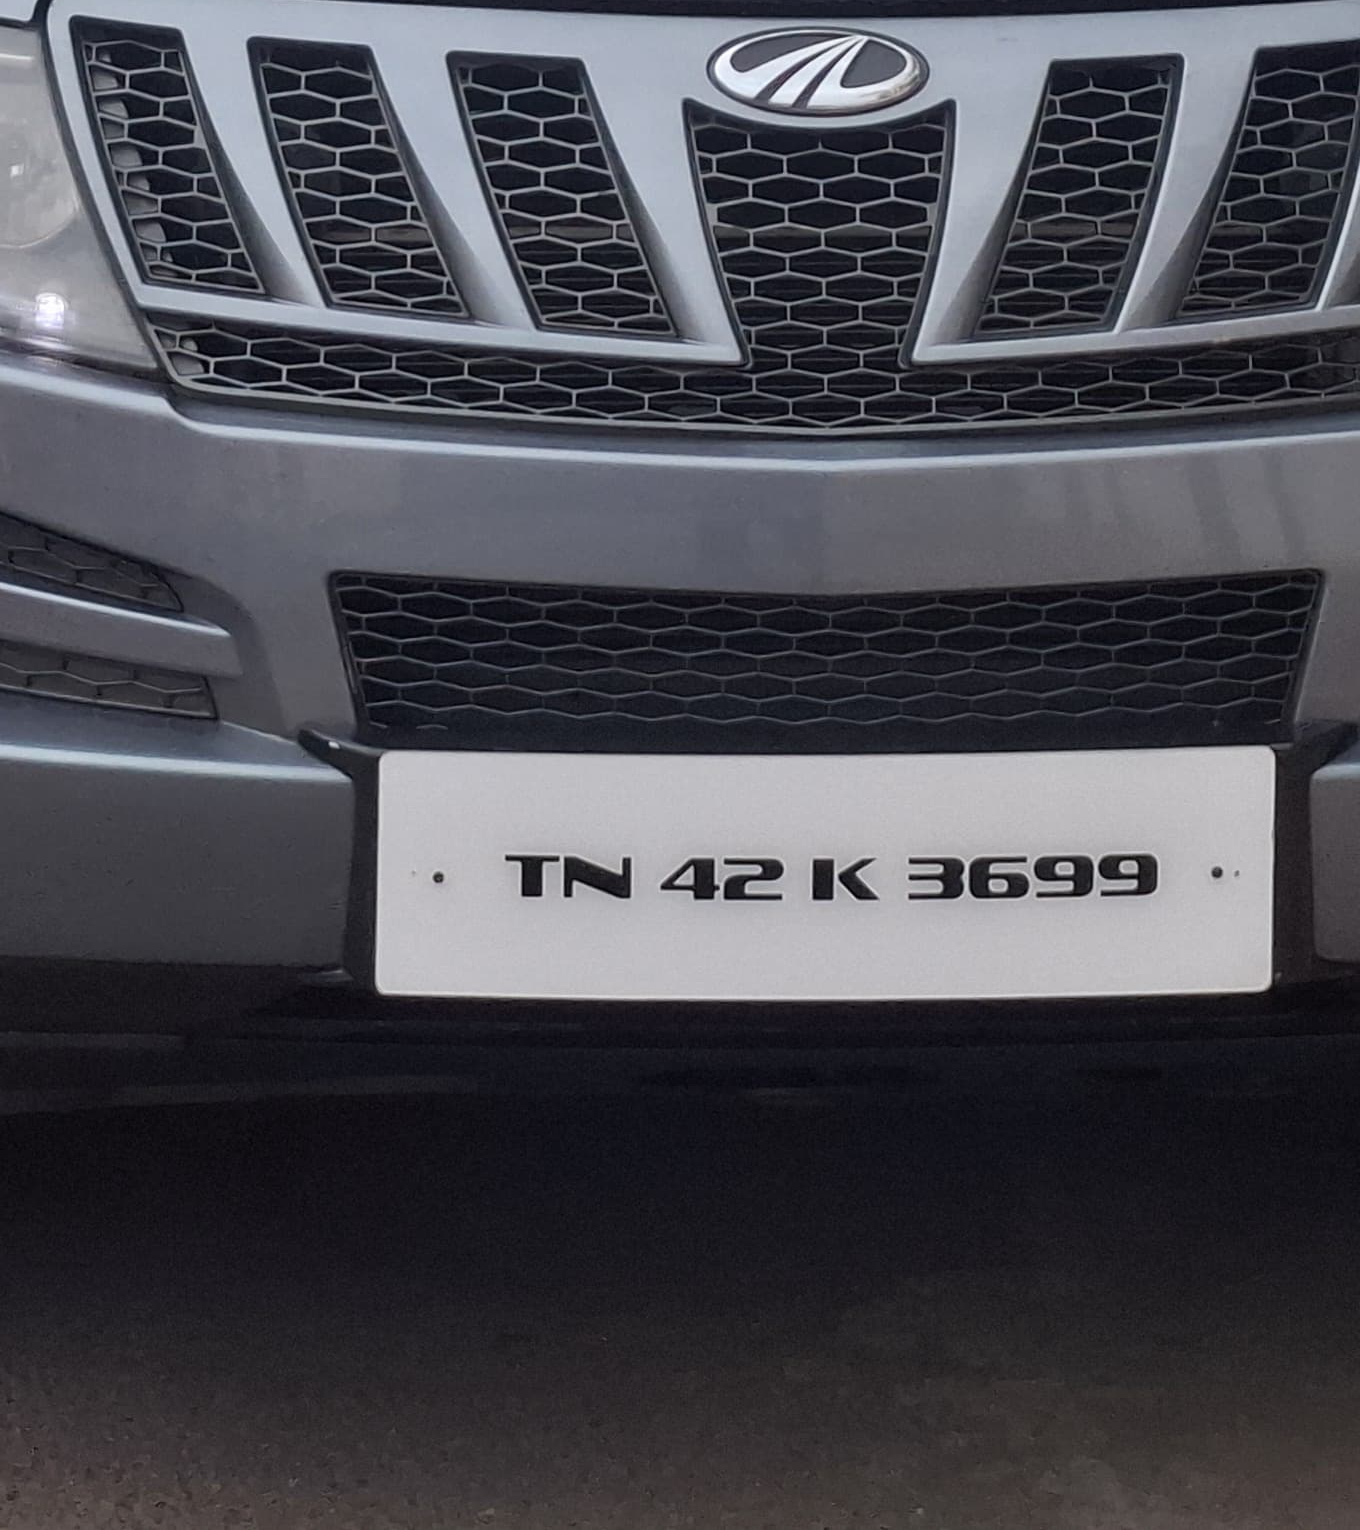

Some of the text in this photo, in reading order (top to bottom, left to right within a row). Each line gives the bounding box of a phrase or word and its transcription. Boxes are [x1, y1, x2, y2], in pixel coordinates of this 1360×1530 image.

[504, 853, 1159, 901] TN 42 K 3699
